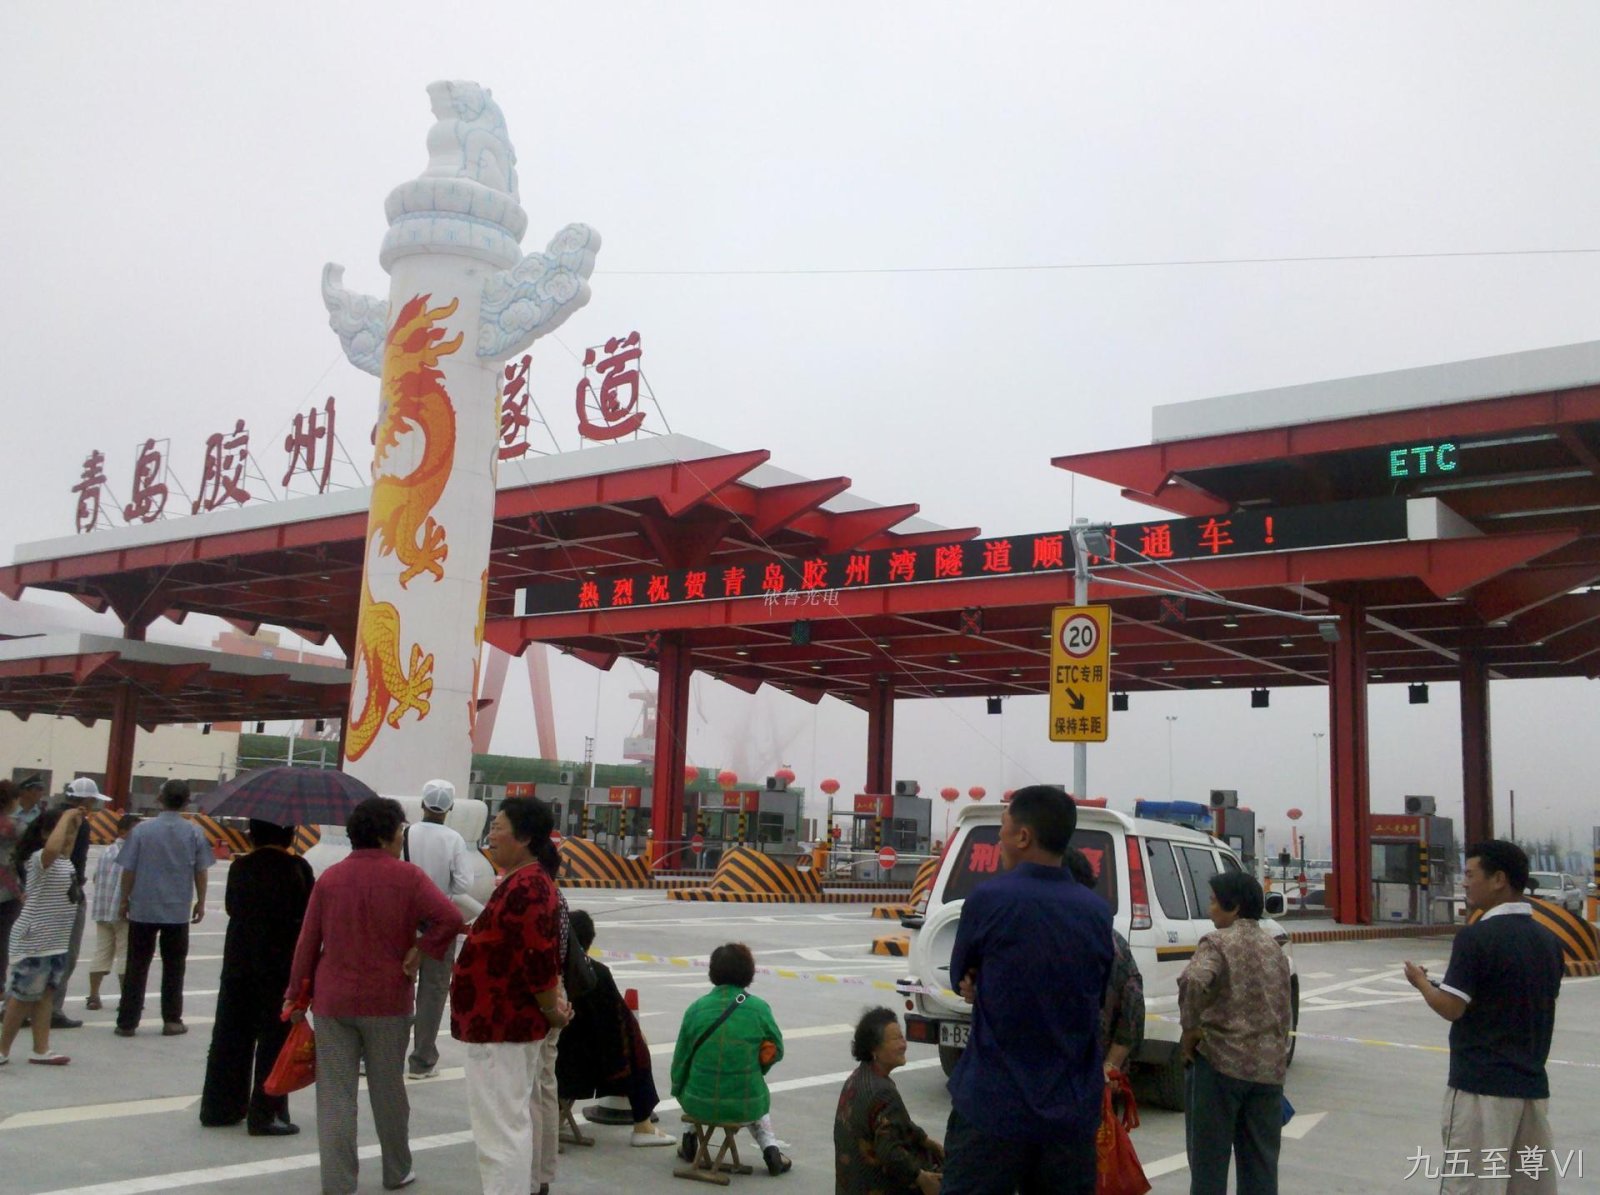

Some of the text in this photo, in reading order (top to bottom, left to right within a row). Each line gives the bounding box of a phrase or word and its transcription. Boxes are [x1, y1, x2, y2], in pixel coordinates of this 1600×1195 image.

[1390, 443, 1457, 477] ETC
[1069, 625, 1093, 647] 20
[1056, 665, 1103, 684] ETC专用
[1055, 716, 1102, 735] 保持车距
